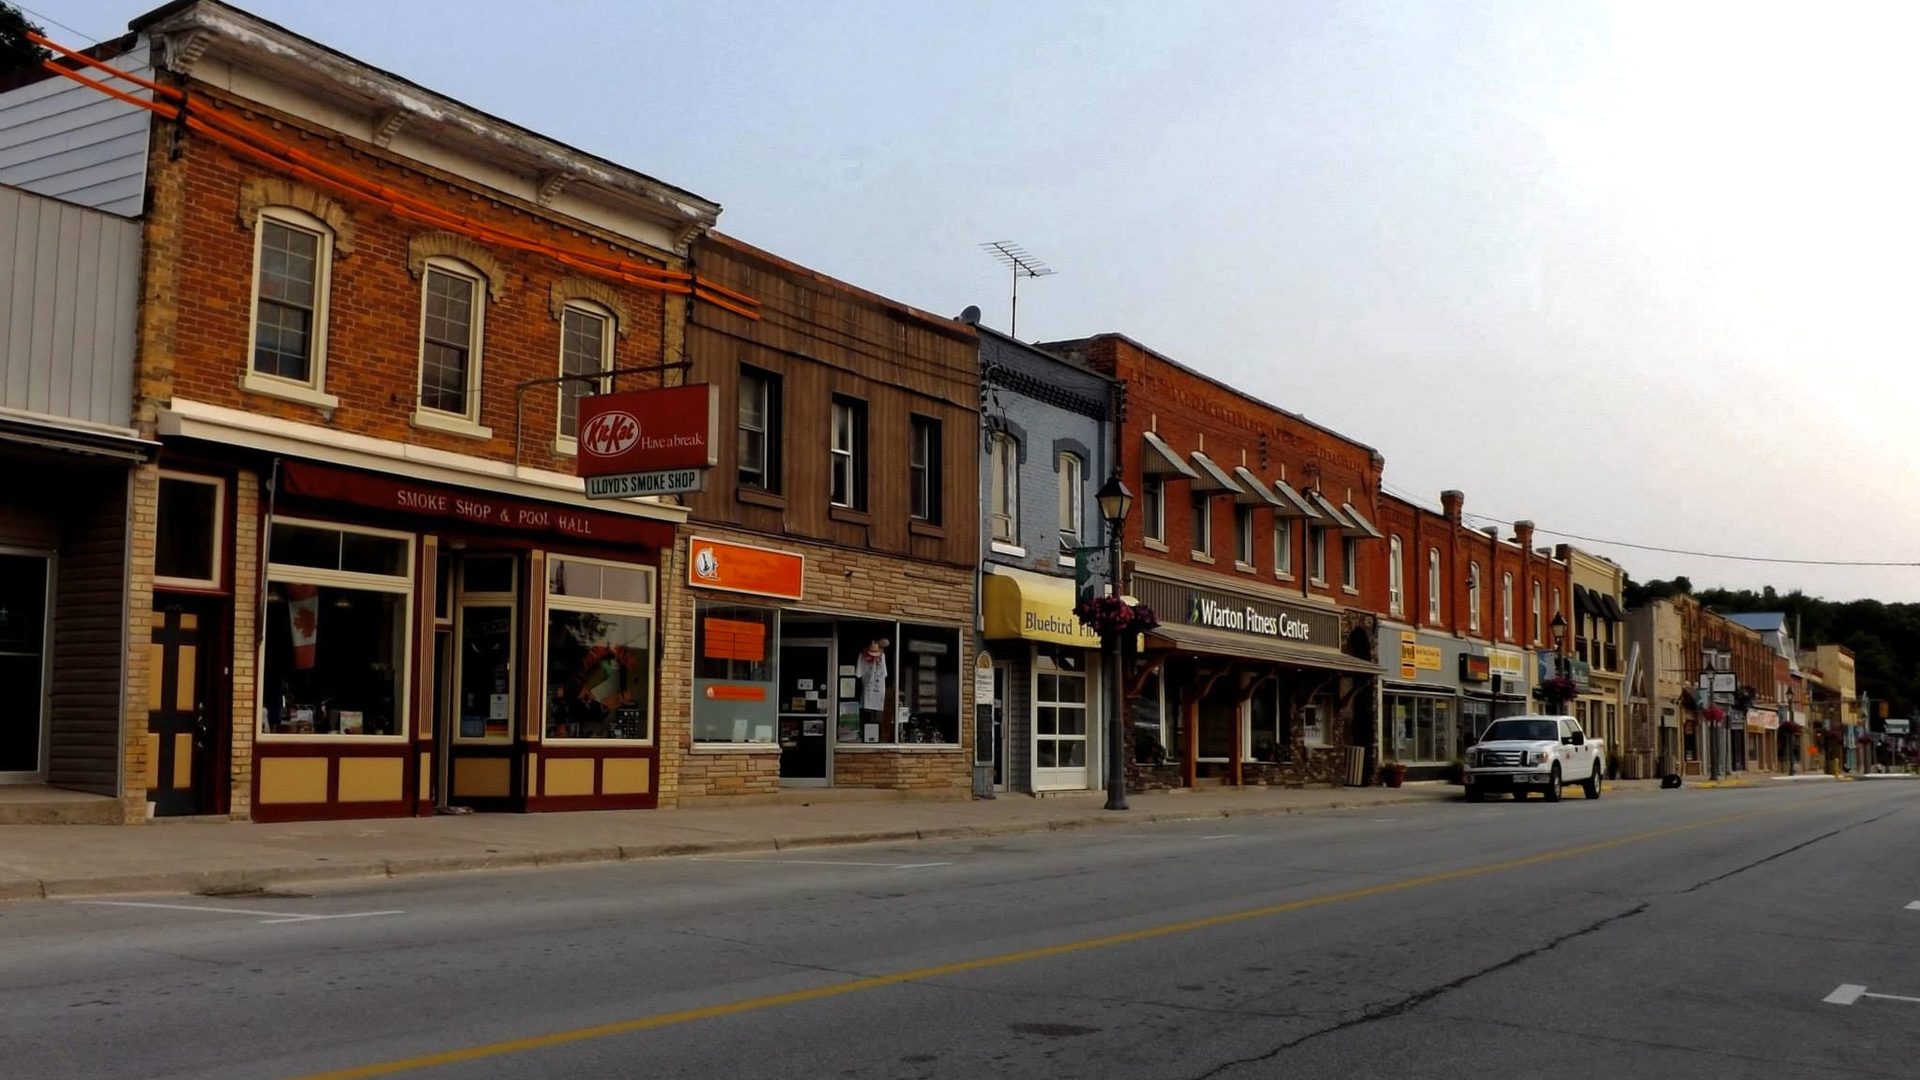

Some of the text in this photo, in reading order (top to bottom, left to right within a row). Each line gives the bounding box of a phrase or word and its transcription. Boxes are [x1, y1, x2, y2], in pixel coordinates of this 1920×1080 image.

[641, 436, 666, 450] Have
[591, 471, 696, 495] LLOYD'S SMOKE SHOP
[397, 490, 591, 534] SMOKE SHOP & POOL HALL
[1025, 612, 1073, 636] Bluebird
[1201, 598, 1310, 640] Wiarton Fitness Centre
